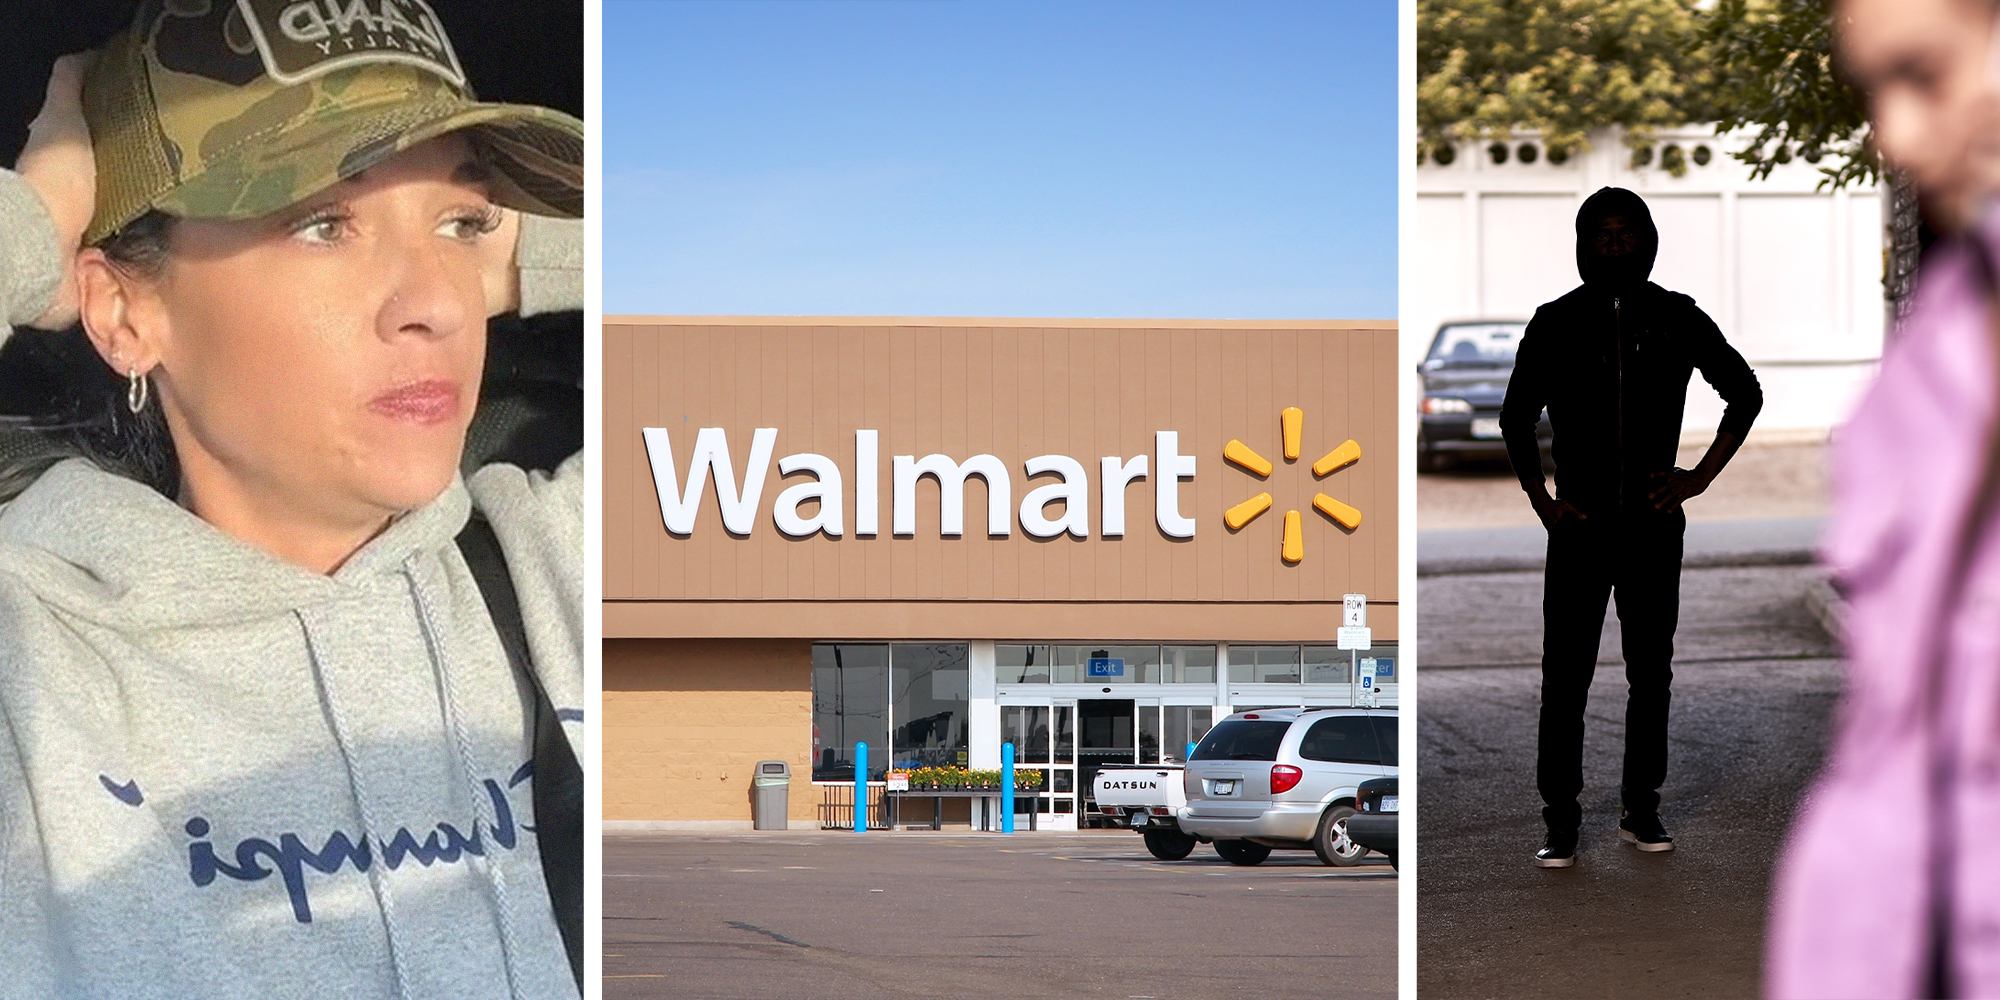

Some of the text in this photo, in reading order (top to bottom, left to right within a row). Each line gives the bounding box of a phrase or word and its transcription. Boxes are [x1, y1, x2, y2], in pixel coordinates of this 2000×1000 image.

[642, 427, 1197, 538] Walmart
[1346, 600, 1363, 610] ROW
[1351, 613, 1358, 622] 4
[1095, 662, 1116, 673] Exit
[1103, 781, 1157, 790] DATSUN
